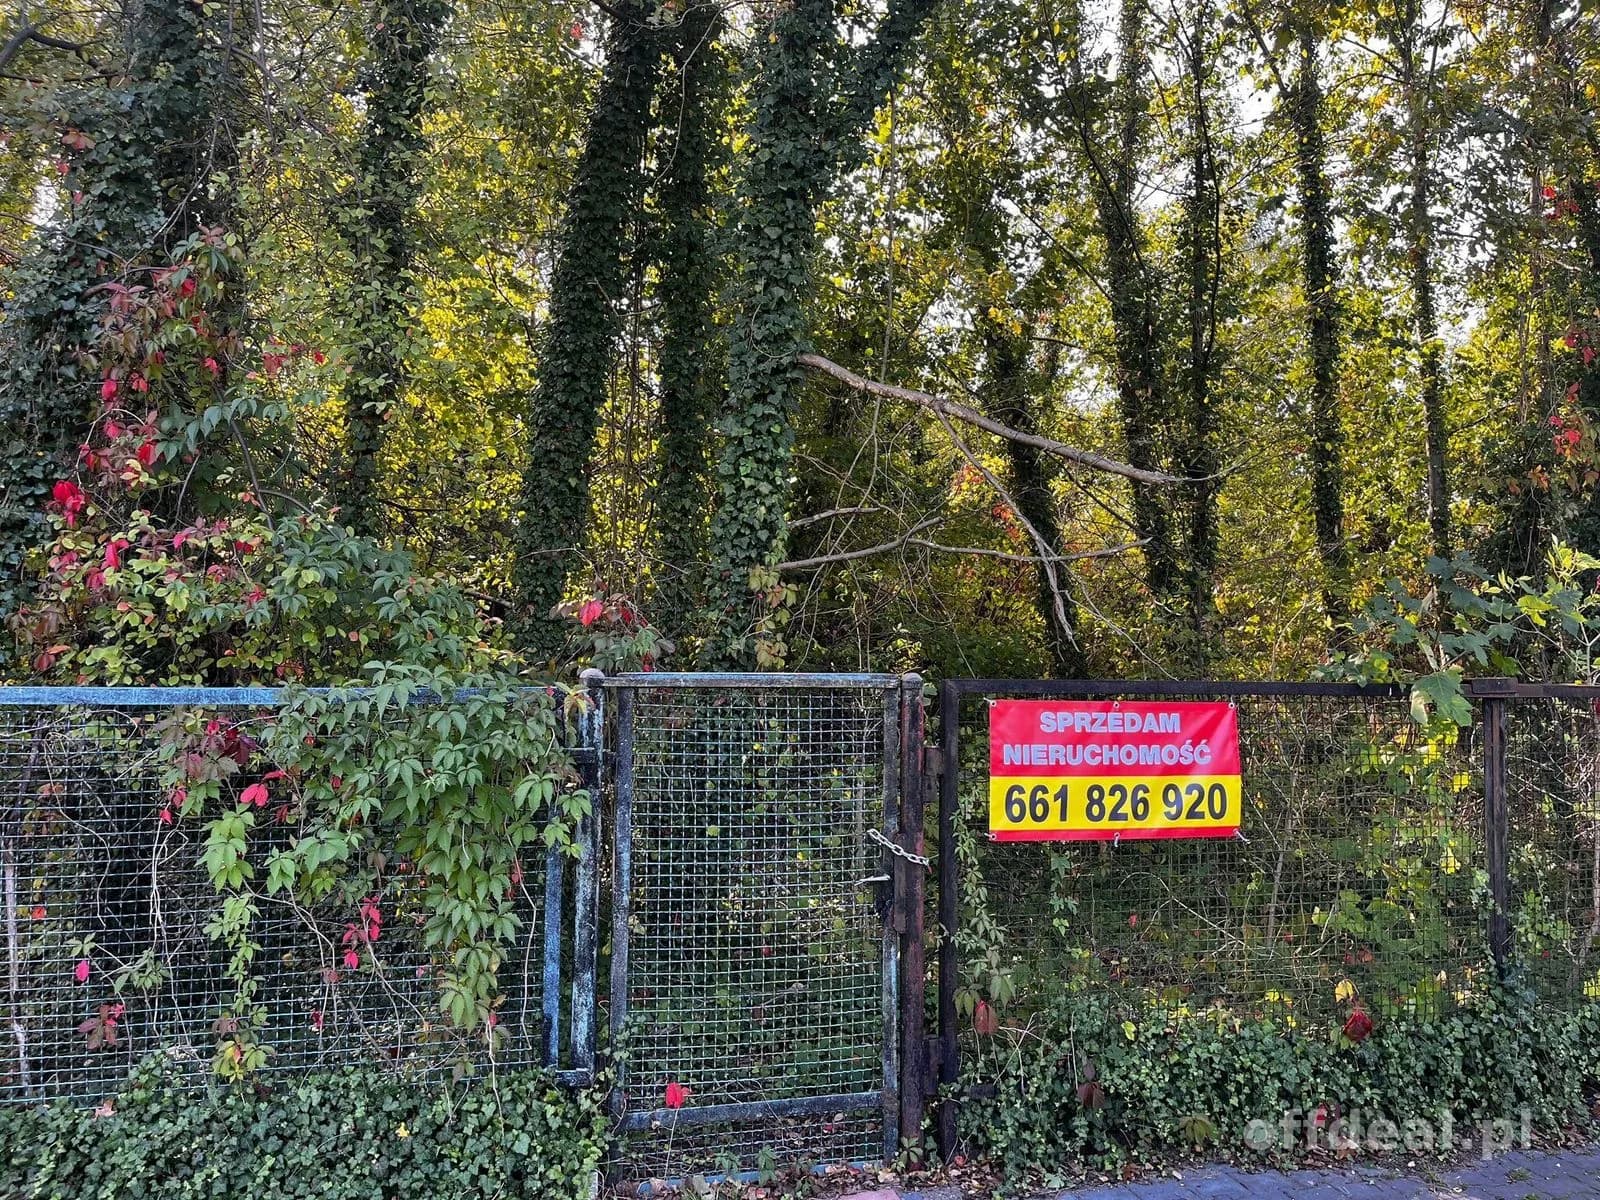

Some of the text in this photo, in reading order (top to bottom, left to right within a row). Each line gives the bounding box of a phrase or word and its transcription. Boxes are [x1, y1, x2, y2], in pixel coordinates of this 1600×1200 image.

[1039, 711, 1181, 733] SPRZEDAM
[1003, 740, 1212, 766] NIERUCHOMOŚĆ
[1004, 782, 1228, 823] 661 826 920
